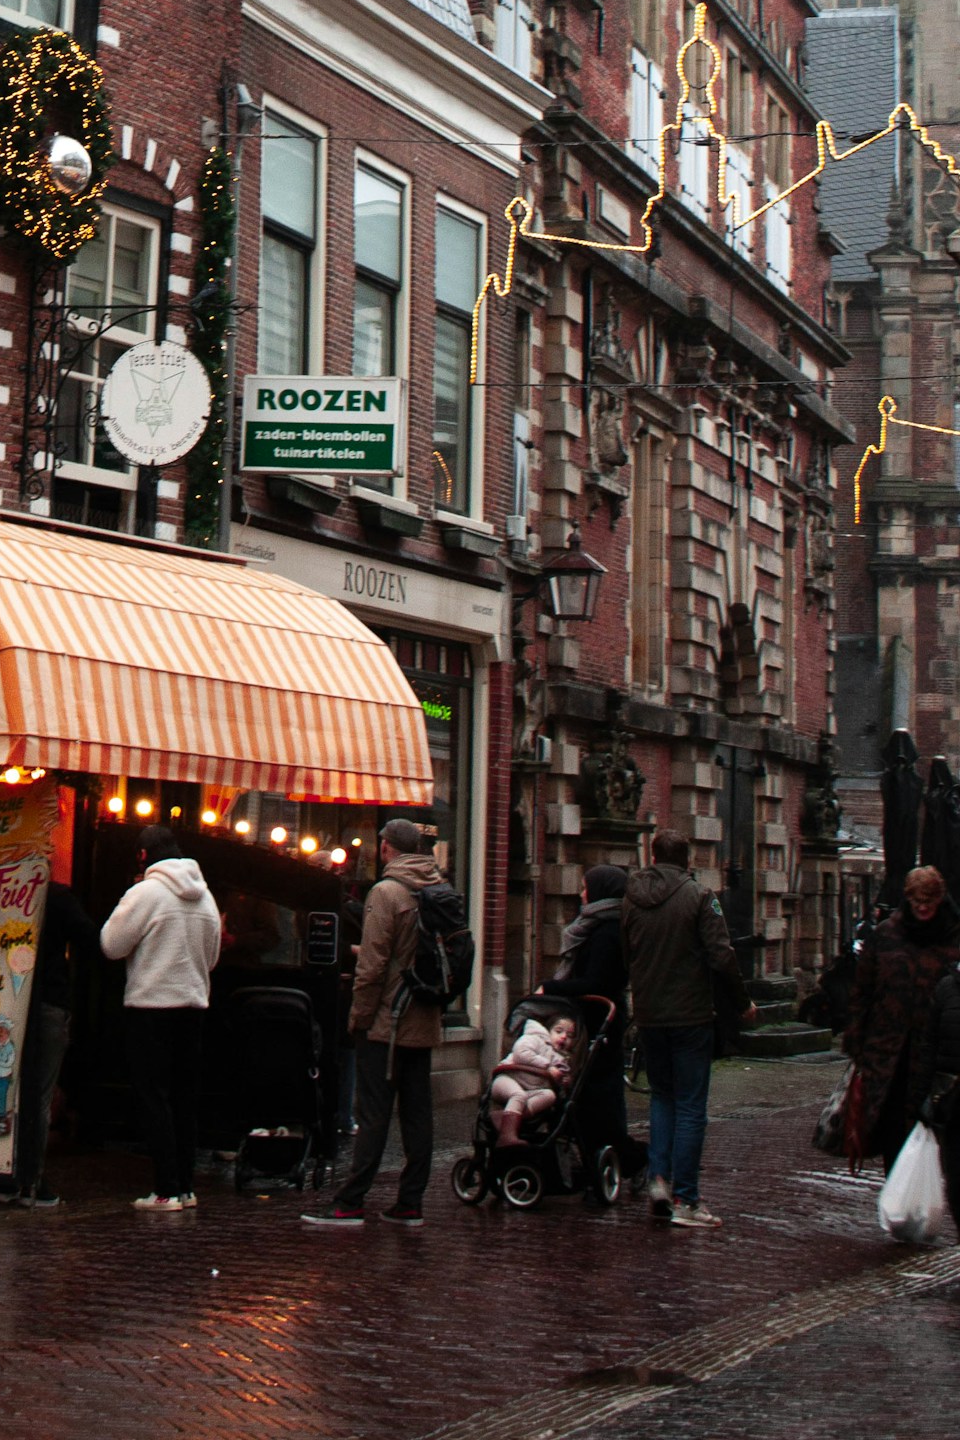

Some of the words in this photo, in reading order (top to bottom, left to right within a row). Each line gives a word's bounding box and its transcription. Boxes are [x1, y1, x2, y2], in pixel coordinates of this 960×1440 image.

[161, 350, 186, 368] friet
[257, 388, 387, 412] ROOZEN
[254, 428, 386, 442] zaden-bloembollen
[273, 446, 366, 460] tuinartikelen
[343, 561, 408, 604] ROOZEN
